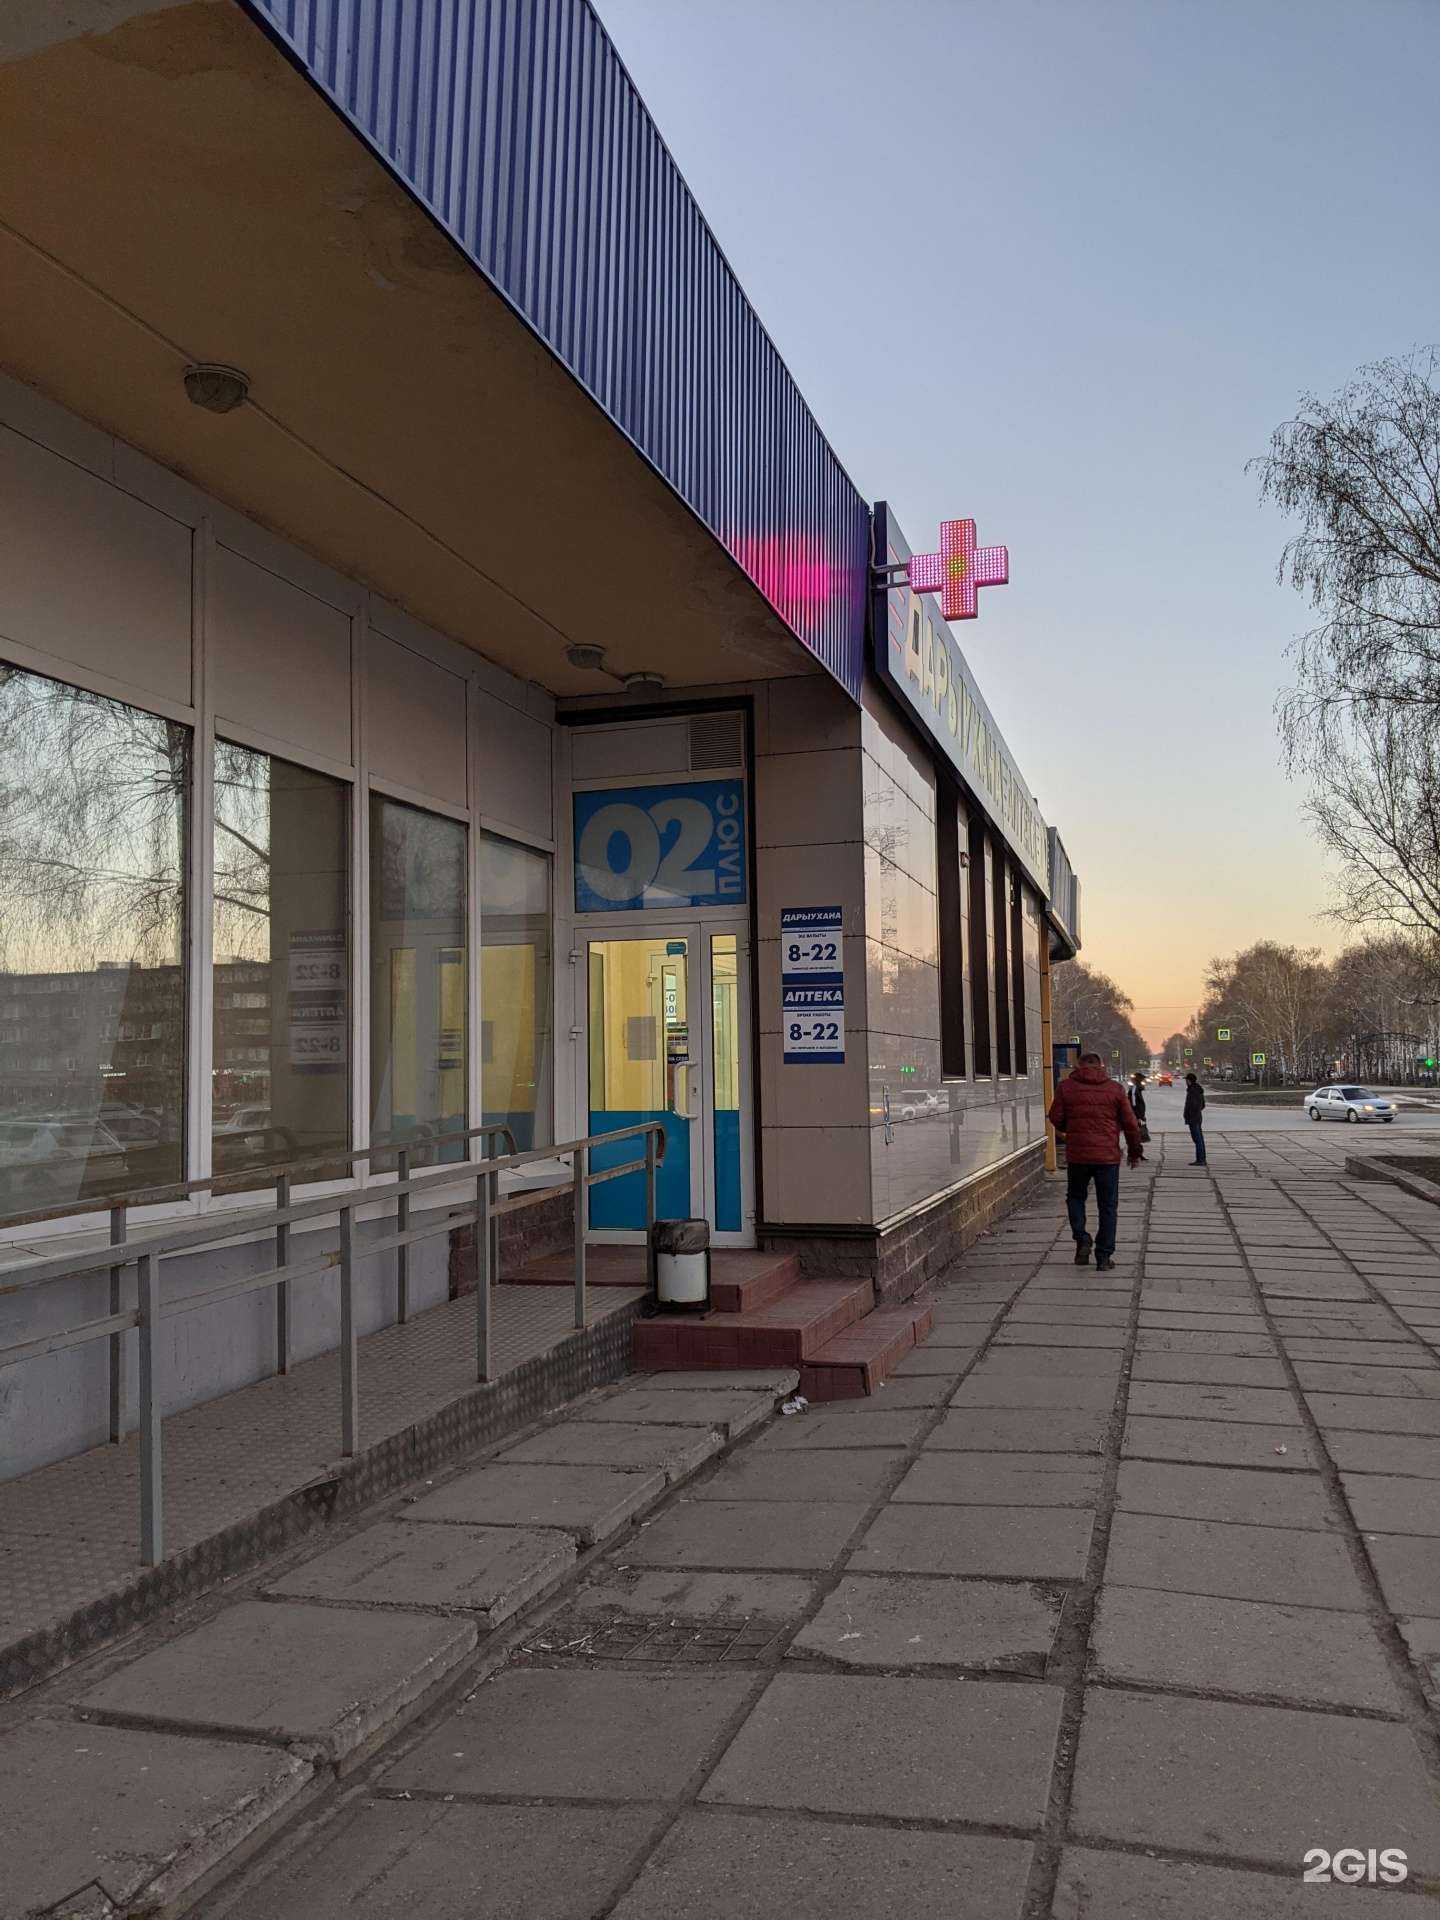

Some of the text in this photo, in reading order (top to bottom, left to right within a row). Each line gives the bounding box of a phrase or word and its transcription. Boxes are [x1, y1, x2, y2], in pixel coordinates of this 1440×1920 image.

[716, 793, 742, 894] ПЛЮС
[783, 912, 841, 922] ДАРЫУХАНА
[788, 944, 837, 962] 8-22
[785, 991, 843, 1002] АПТЕКА
[789, 1023, 839, 1041] 8-22
